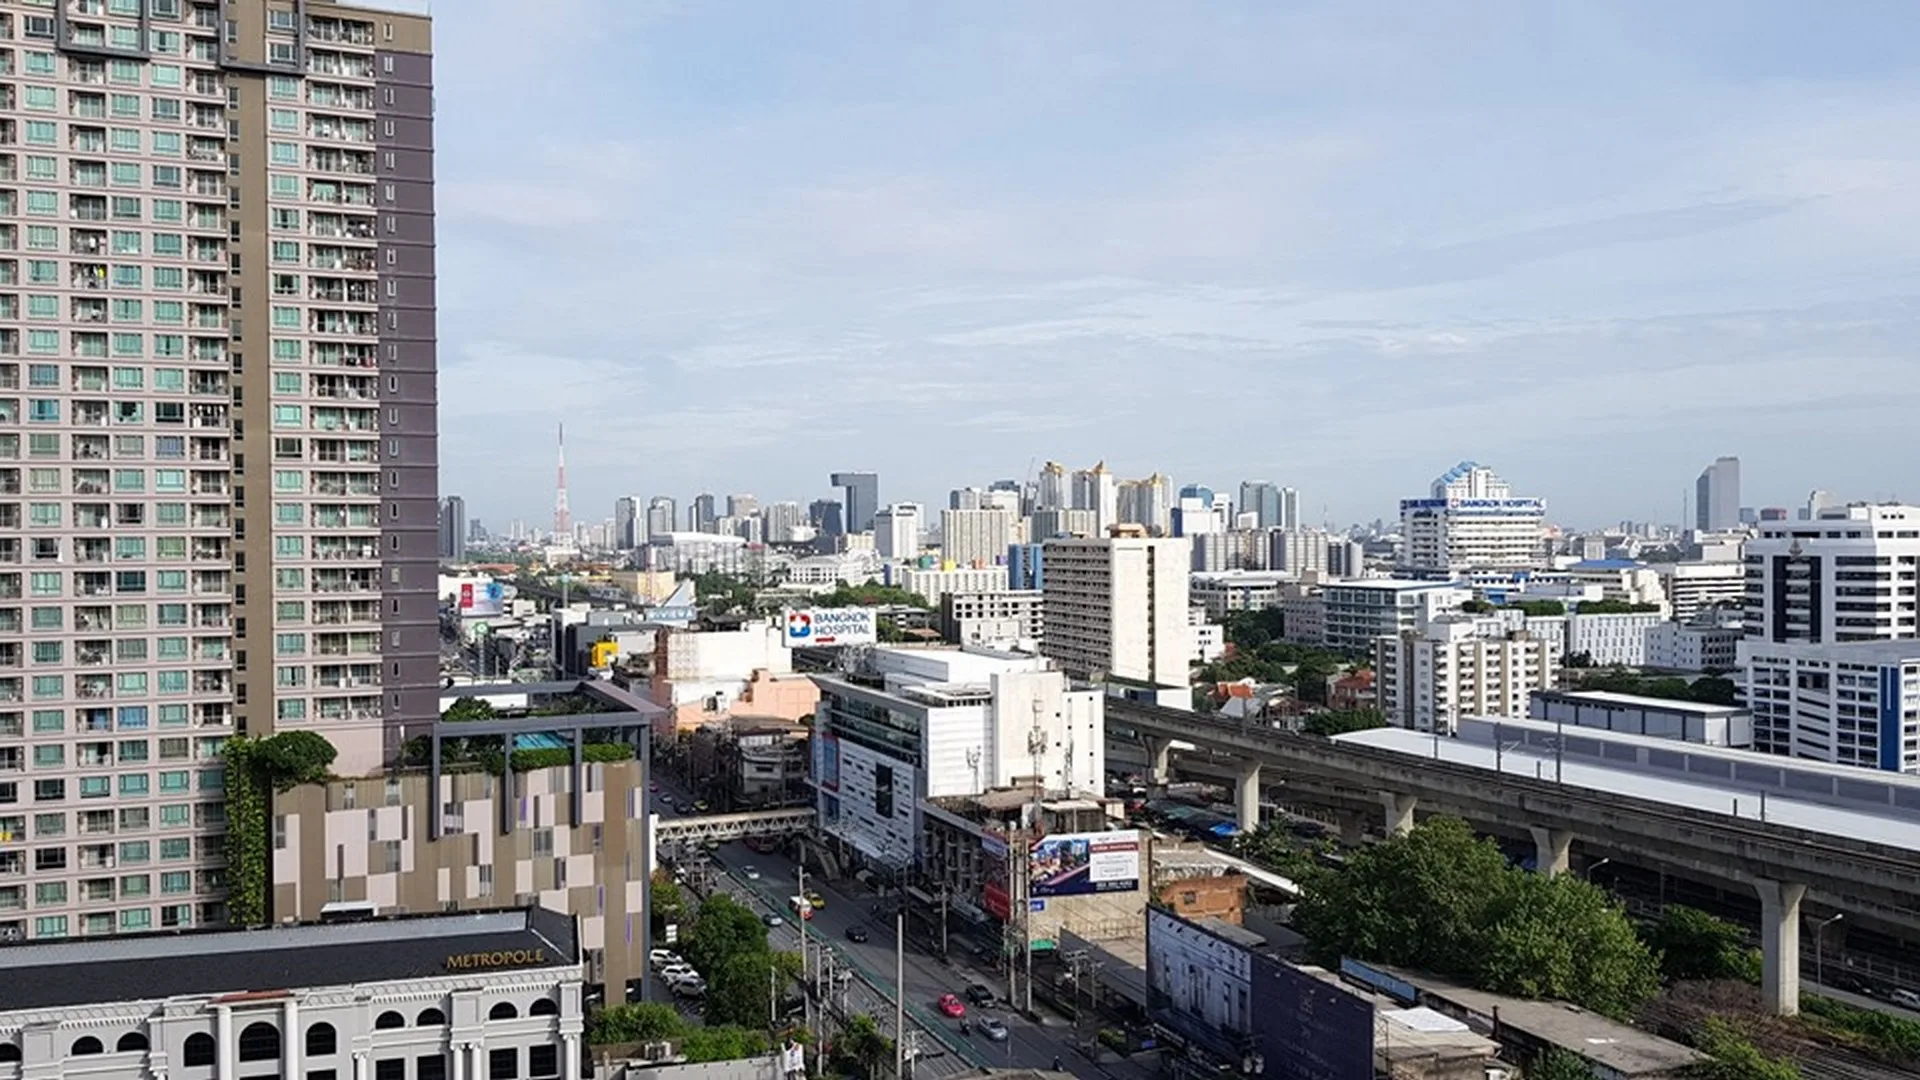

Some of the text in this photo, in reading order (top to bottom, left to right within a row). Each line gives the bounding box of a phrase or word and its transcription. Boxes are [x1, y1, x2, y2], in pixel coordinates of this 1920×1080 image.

[1460, 499, 1543, 508] BANGKOK HOSPITAL
[814, 611, 870, 624] BANGKOK
[814, 624, 870, 635] HOSPITAL
[447, 950, 545, 968] METROPOLE
